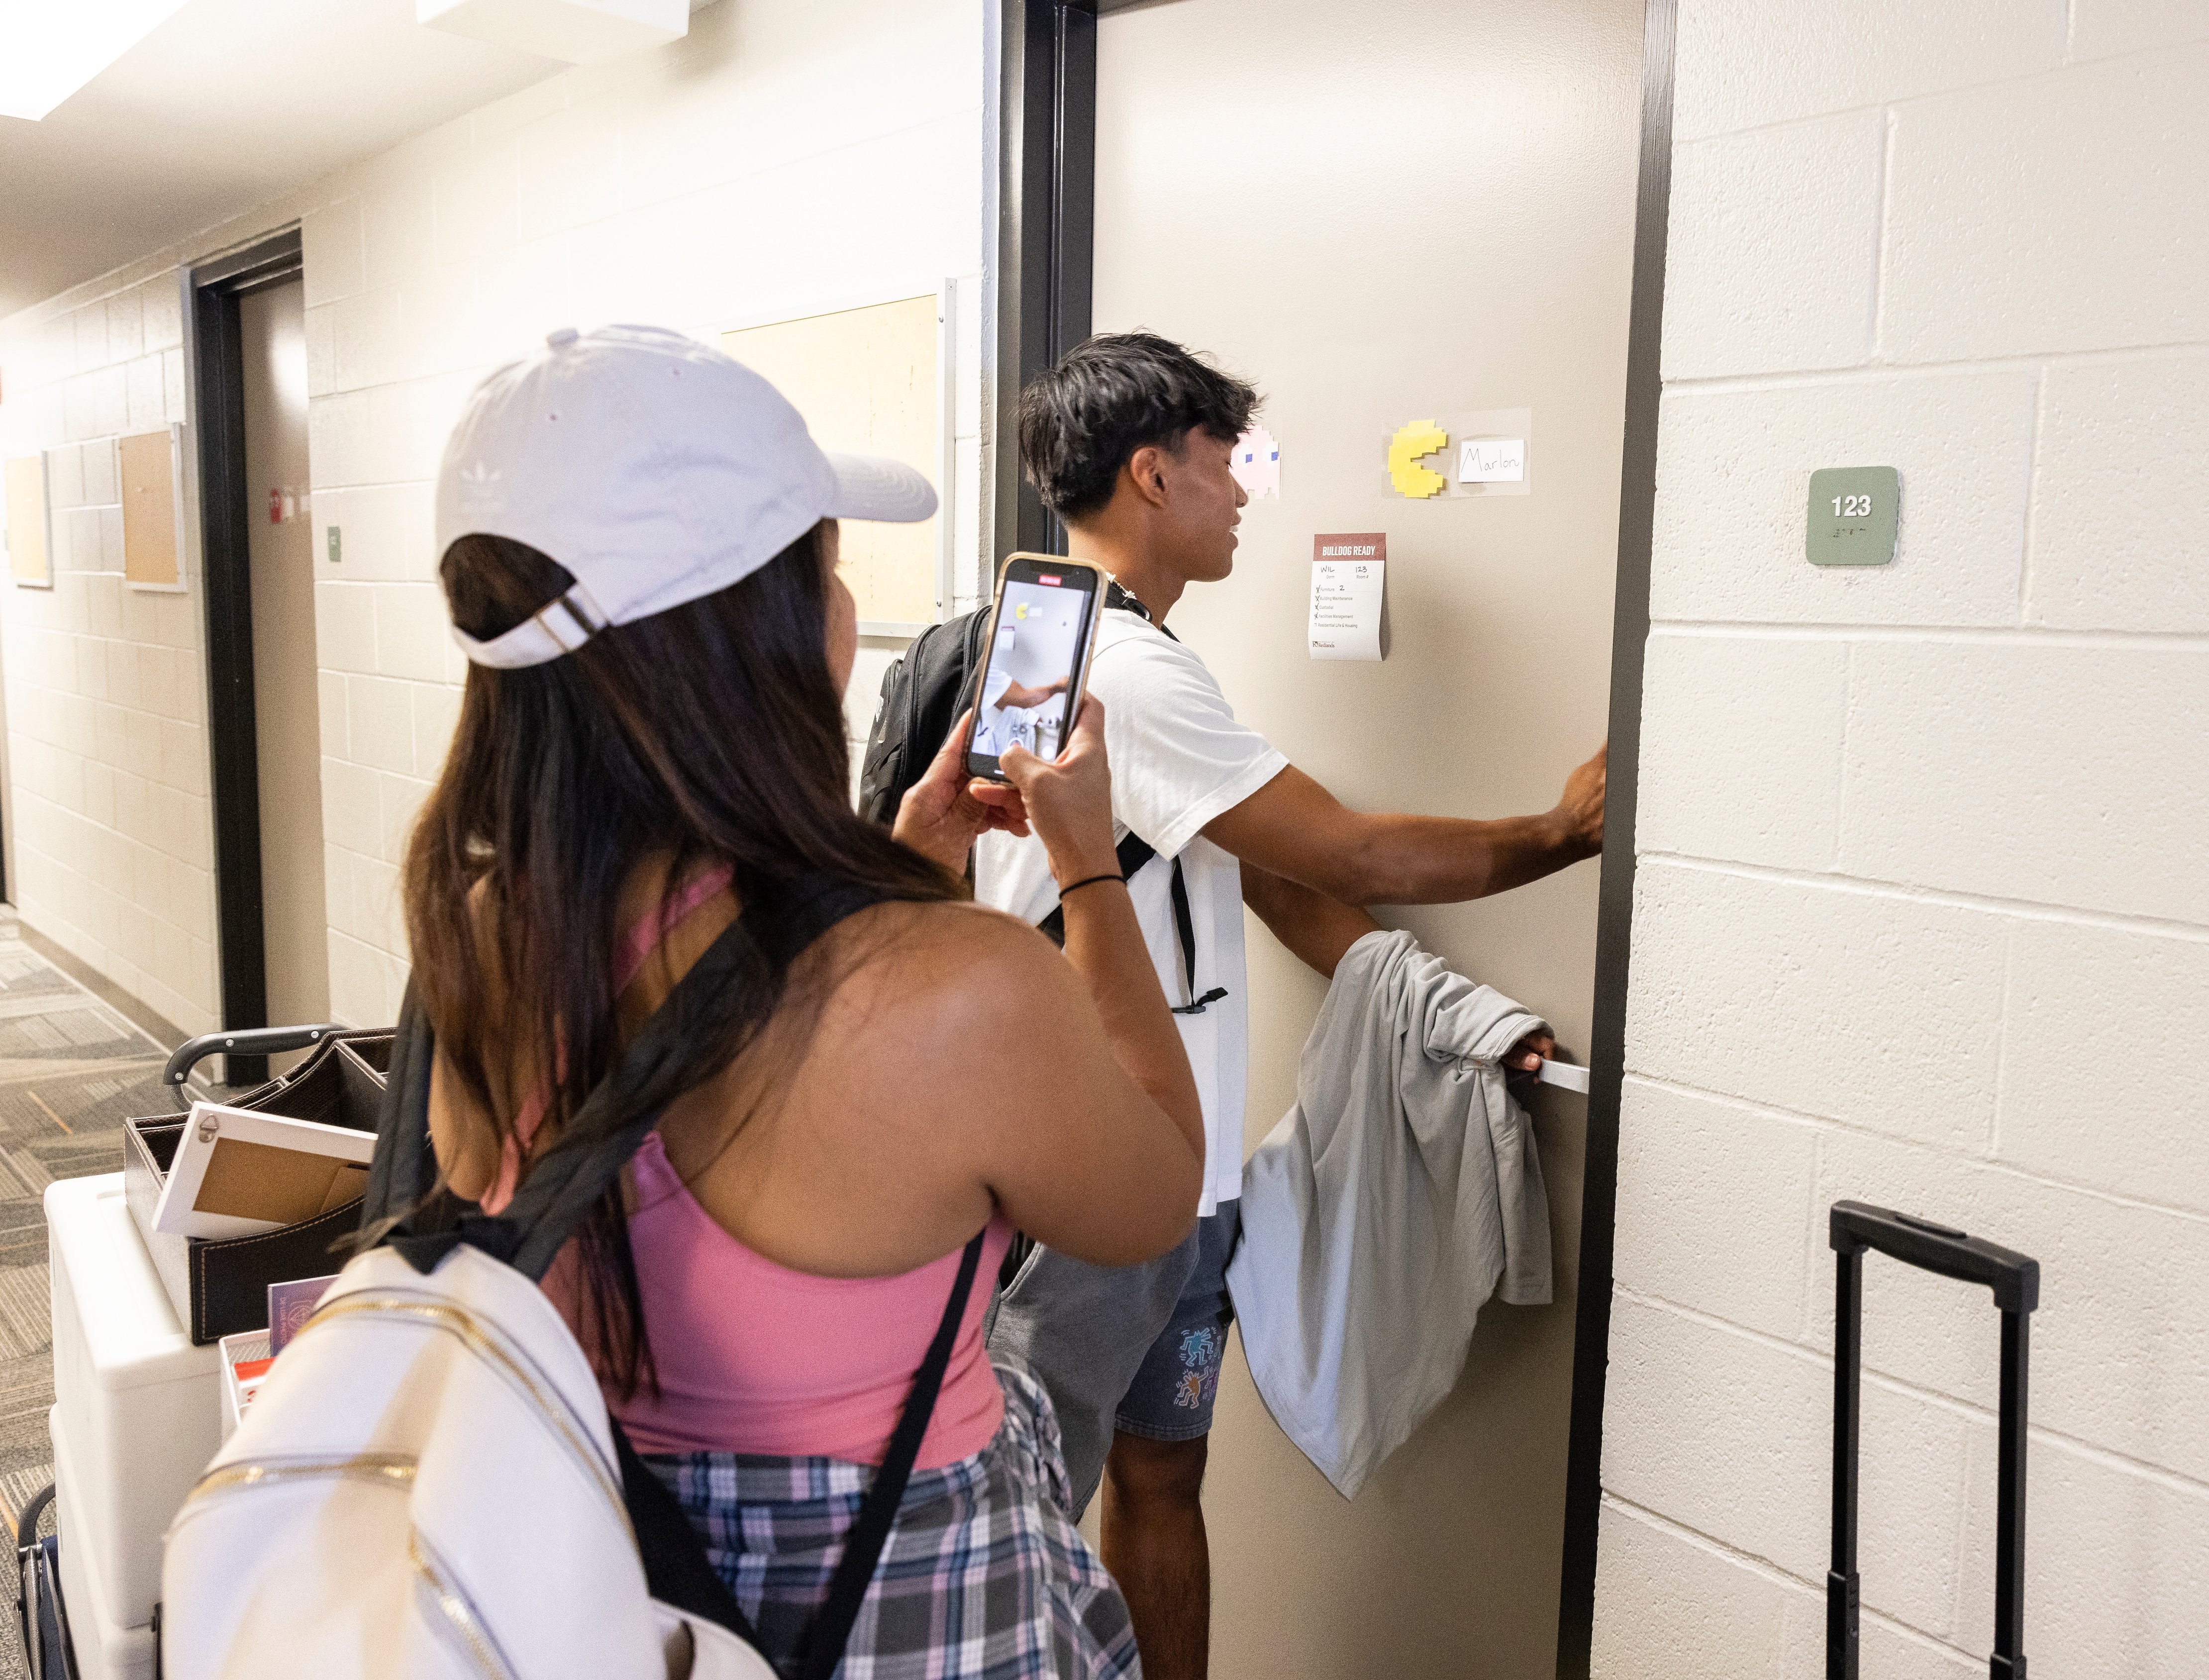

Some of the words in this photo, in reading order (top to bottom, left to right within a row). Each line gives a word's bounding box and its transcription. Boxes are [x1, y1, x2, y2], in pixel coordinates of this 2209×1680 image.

[1461, 448, 1519, 473] Marlon
[1831, 495, 1871, 516] 123
[1322, 546, 1352, 556] BULLDOG
[1353, 545, 1376, 556] READY
